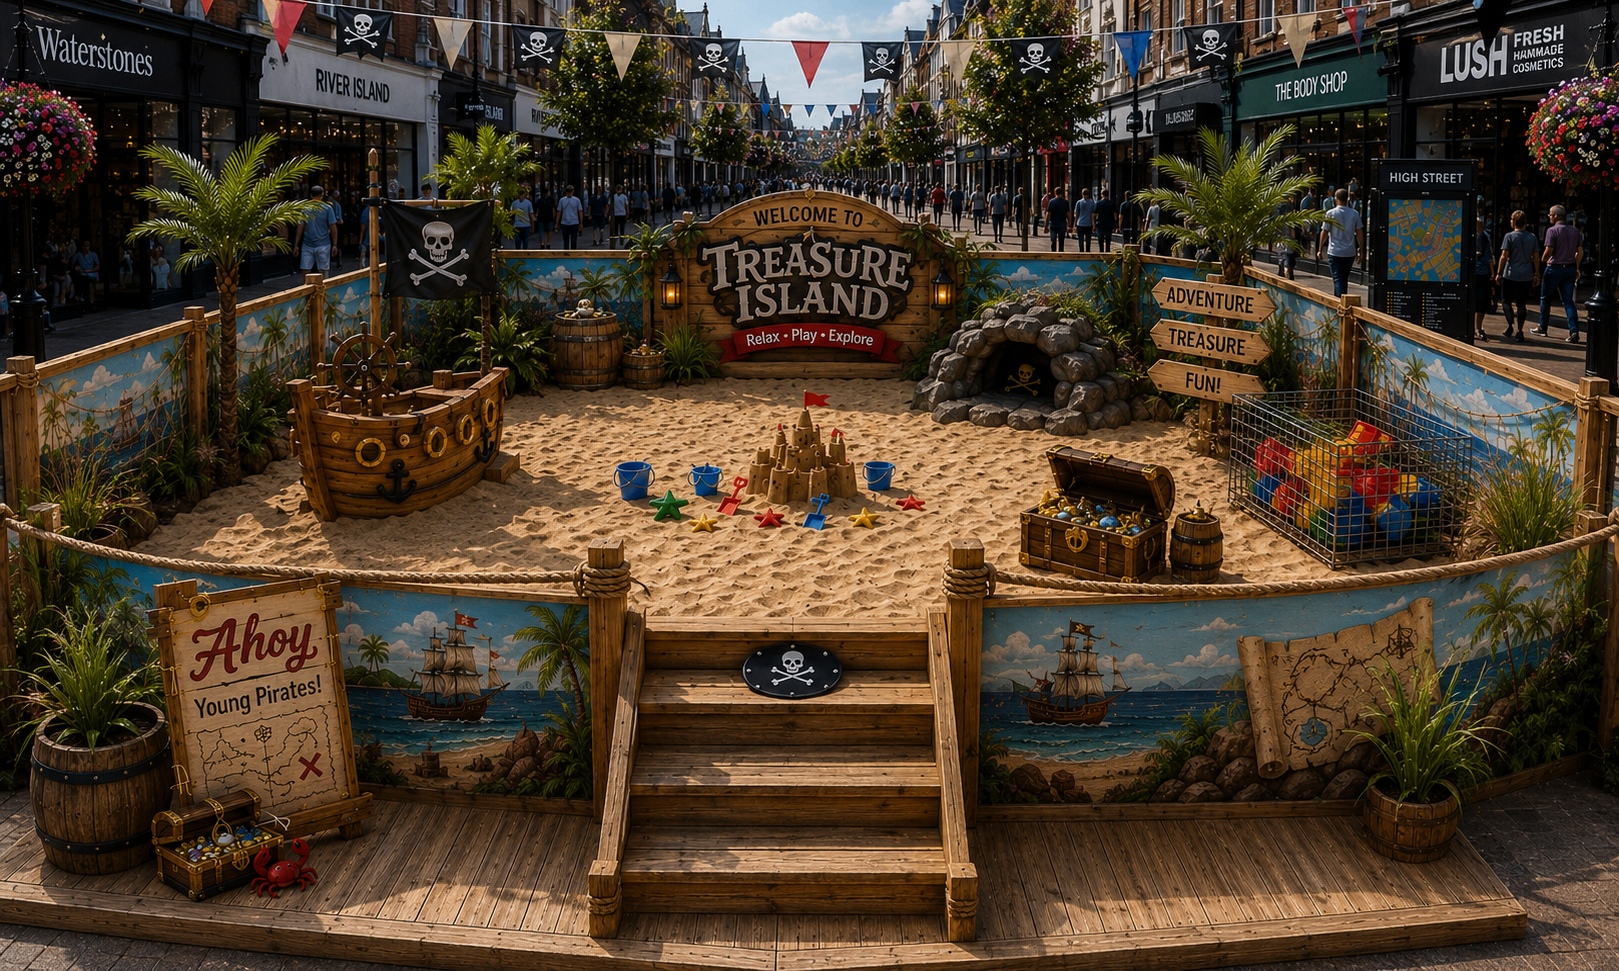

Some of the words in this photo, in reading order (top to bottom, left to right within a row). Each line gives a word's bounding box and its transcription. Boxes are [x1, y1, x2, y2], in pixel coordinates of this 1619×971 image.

[1513, 24, 1564, 48] FRESH
[35, 25, 154, 78] Waterstones
[1440, 35, 1508, 84] LUSH
[1512, 57, 1564, 74] COSMETICS
[315, 68, 350, 97] RIVER
[353, 76, 390, 104] ISLAND
[1275, 82, 1293, 102] THE
[1293, 76, 1317, 99] BODY
[1319, 70, 1348, 94] SHOP
[1389, 172, 1418, 183] HIGH
[1422, 172, 1464, 184] STREET
[753, 206, 837, 228] WELCOME
[843, 209, 863, 228] TO
[702, 241, 912, 292] TREASURE
[734, 281, 889, 324] ISLAND
[1166, 286, 1254, 314] ADVENTURE
[746, 332, 780, 347] Relax
[791, 328, 818, 344] Play
[828, 329, 874, 347] Explore
[1168, 327, 1246, 356] TREASURE
[1185, 371, 1221, 394] FUN!
[189, 612, 318, 682] Ahoy
[194, 693, 251, 718] Young
[255, 674, 322, 706] Pirates!
